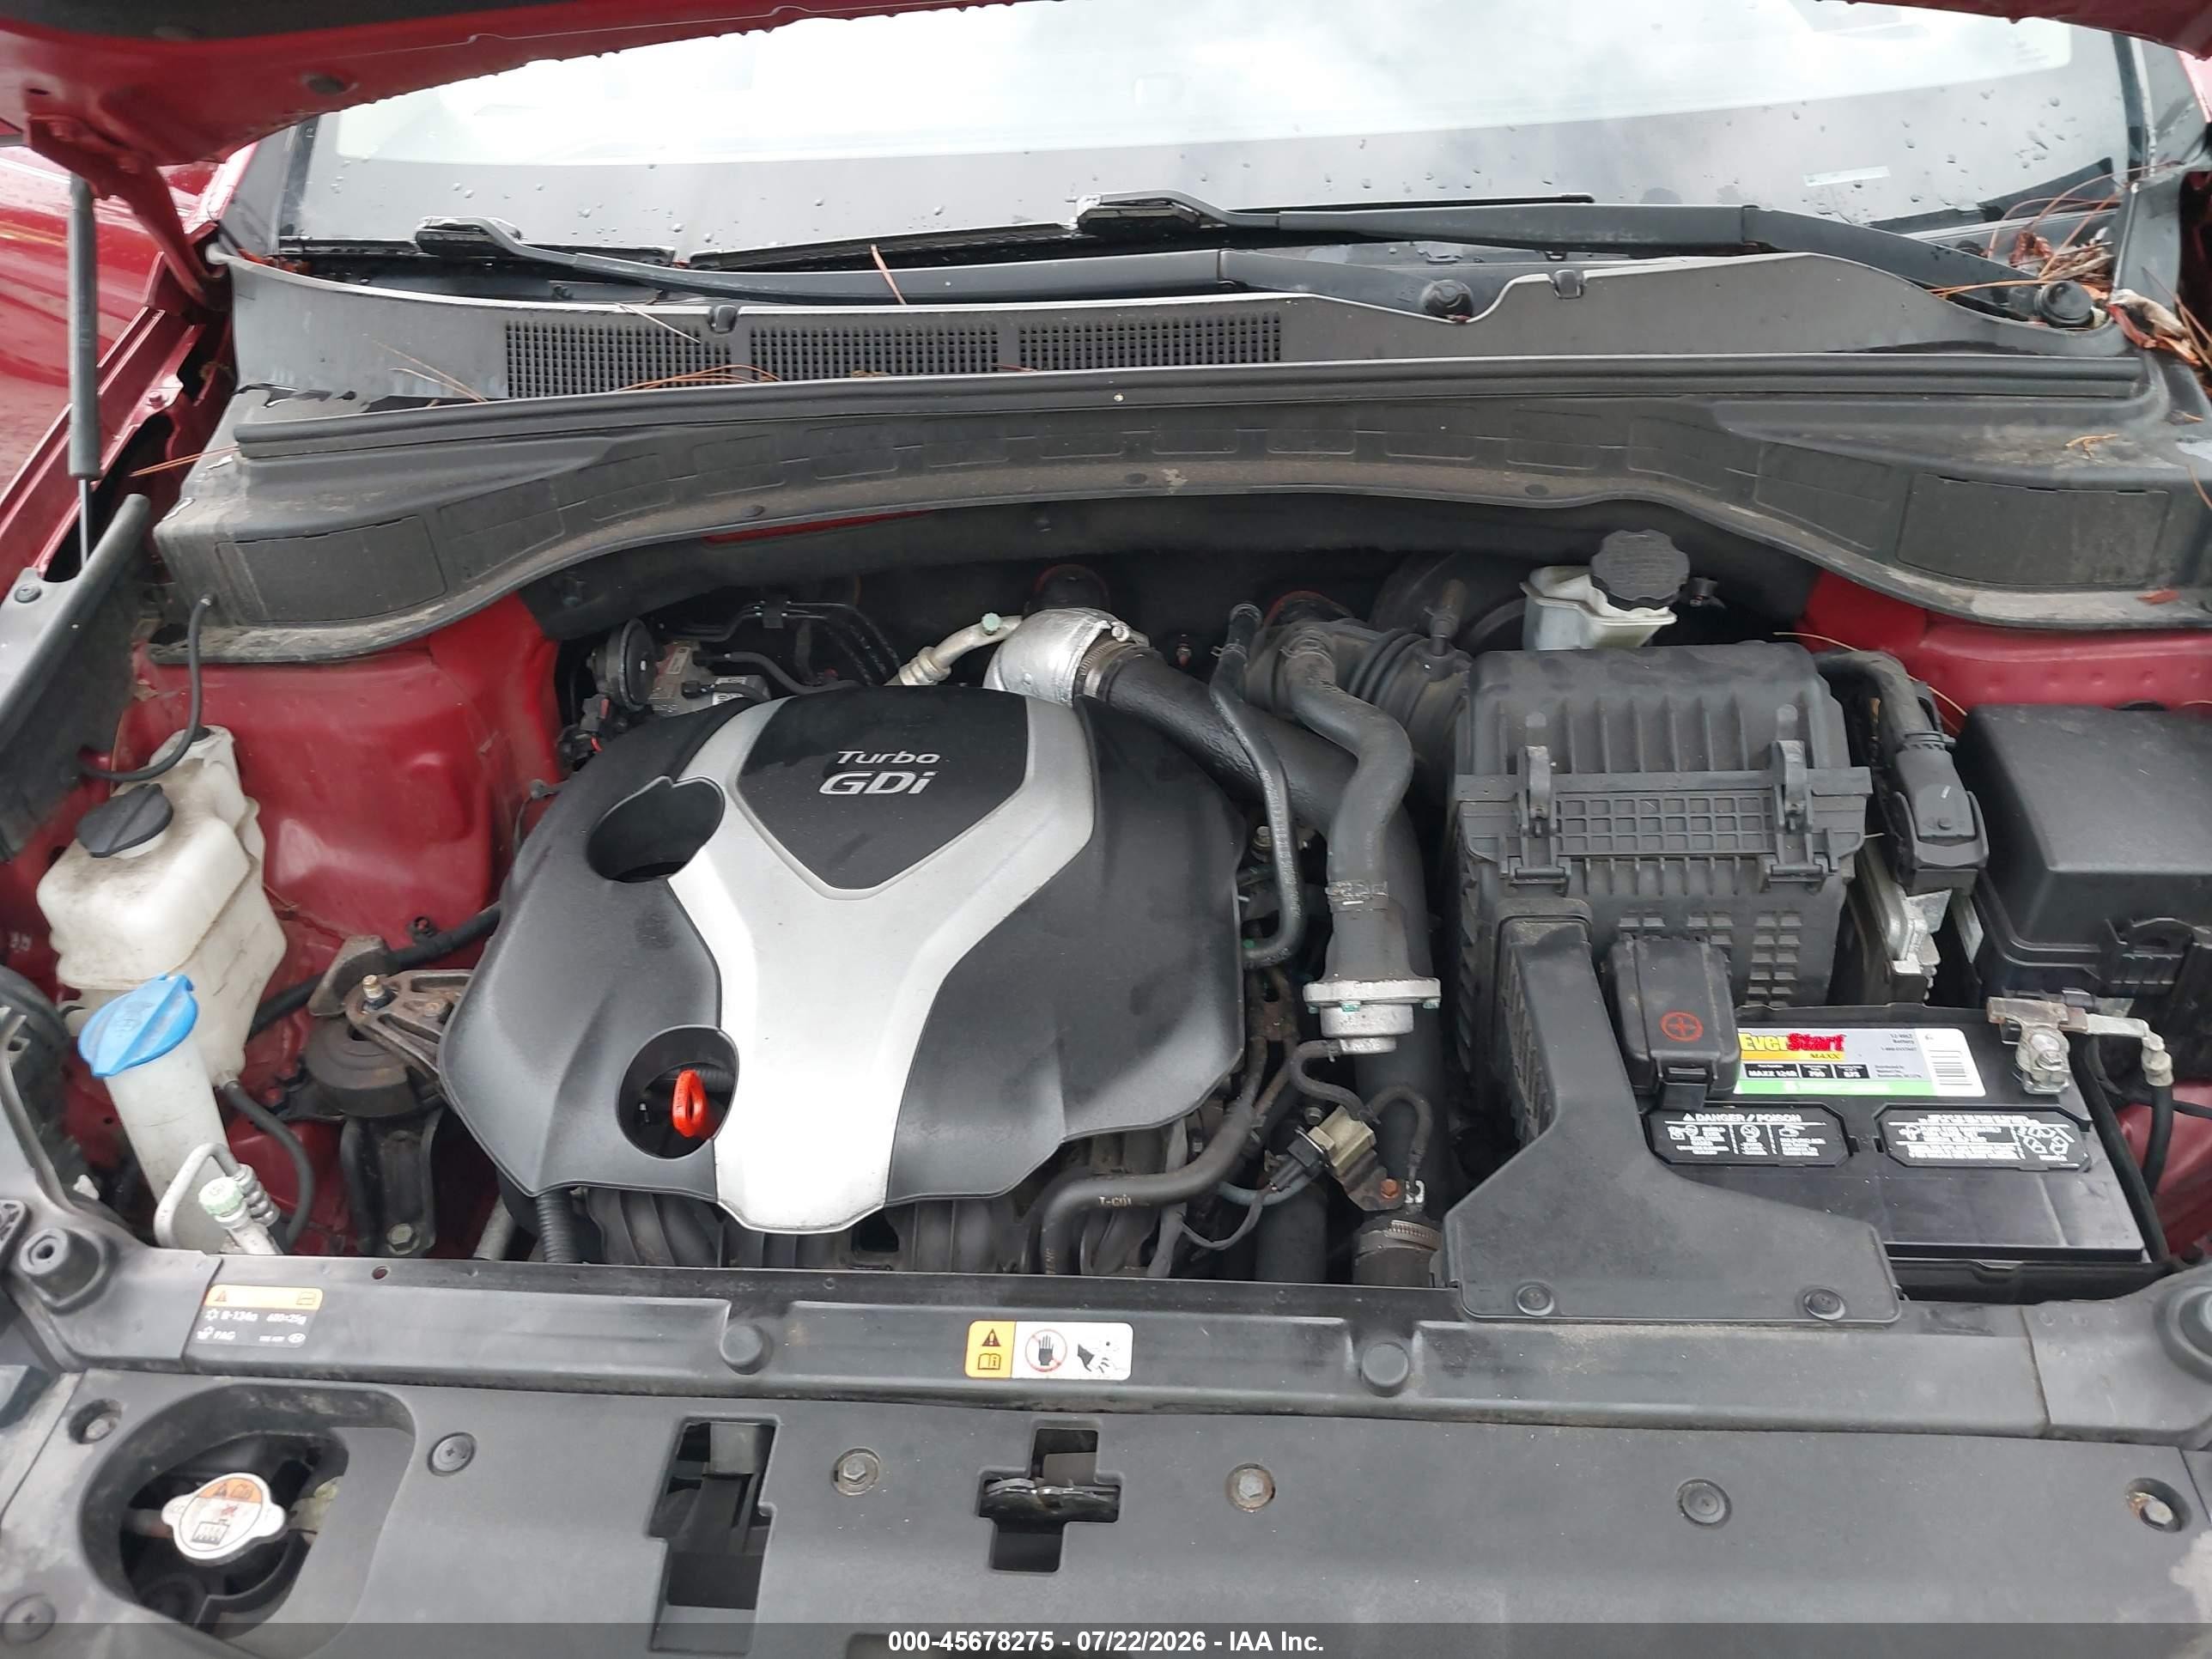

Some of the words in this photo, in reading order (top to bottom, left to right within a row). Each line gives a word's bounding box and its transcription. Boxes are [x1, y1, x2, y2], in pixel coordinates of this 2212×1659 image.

[837, 750, 941, 763] Turbo
[818, 771, 939, 795] GDi
[1738, 1032, 1844, 1052] EverStart
[1695, 1114, 1745, 1122] DANGER
[1756, 1115, 1802, 1123] POISON
